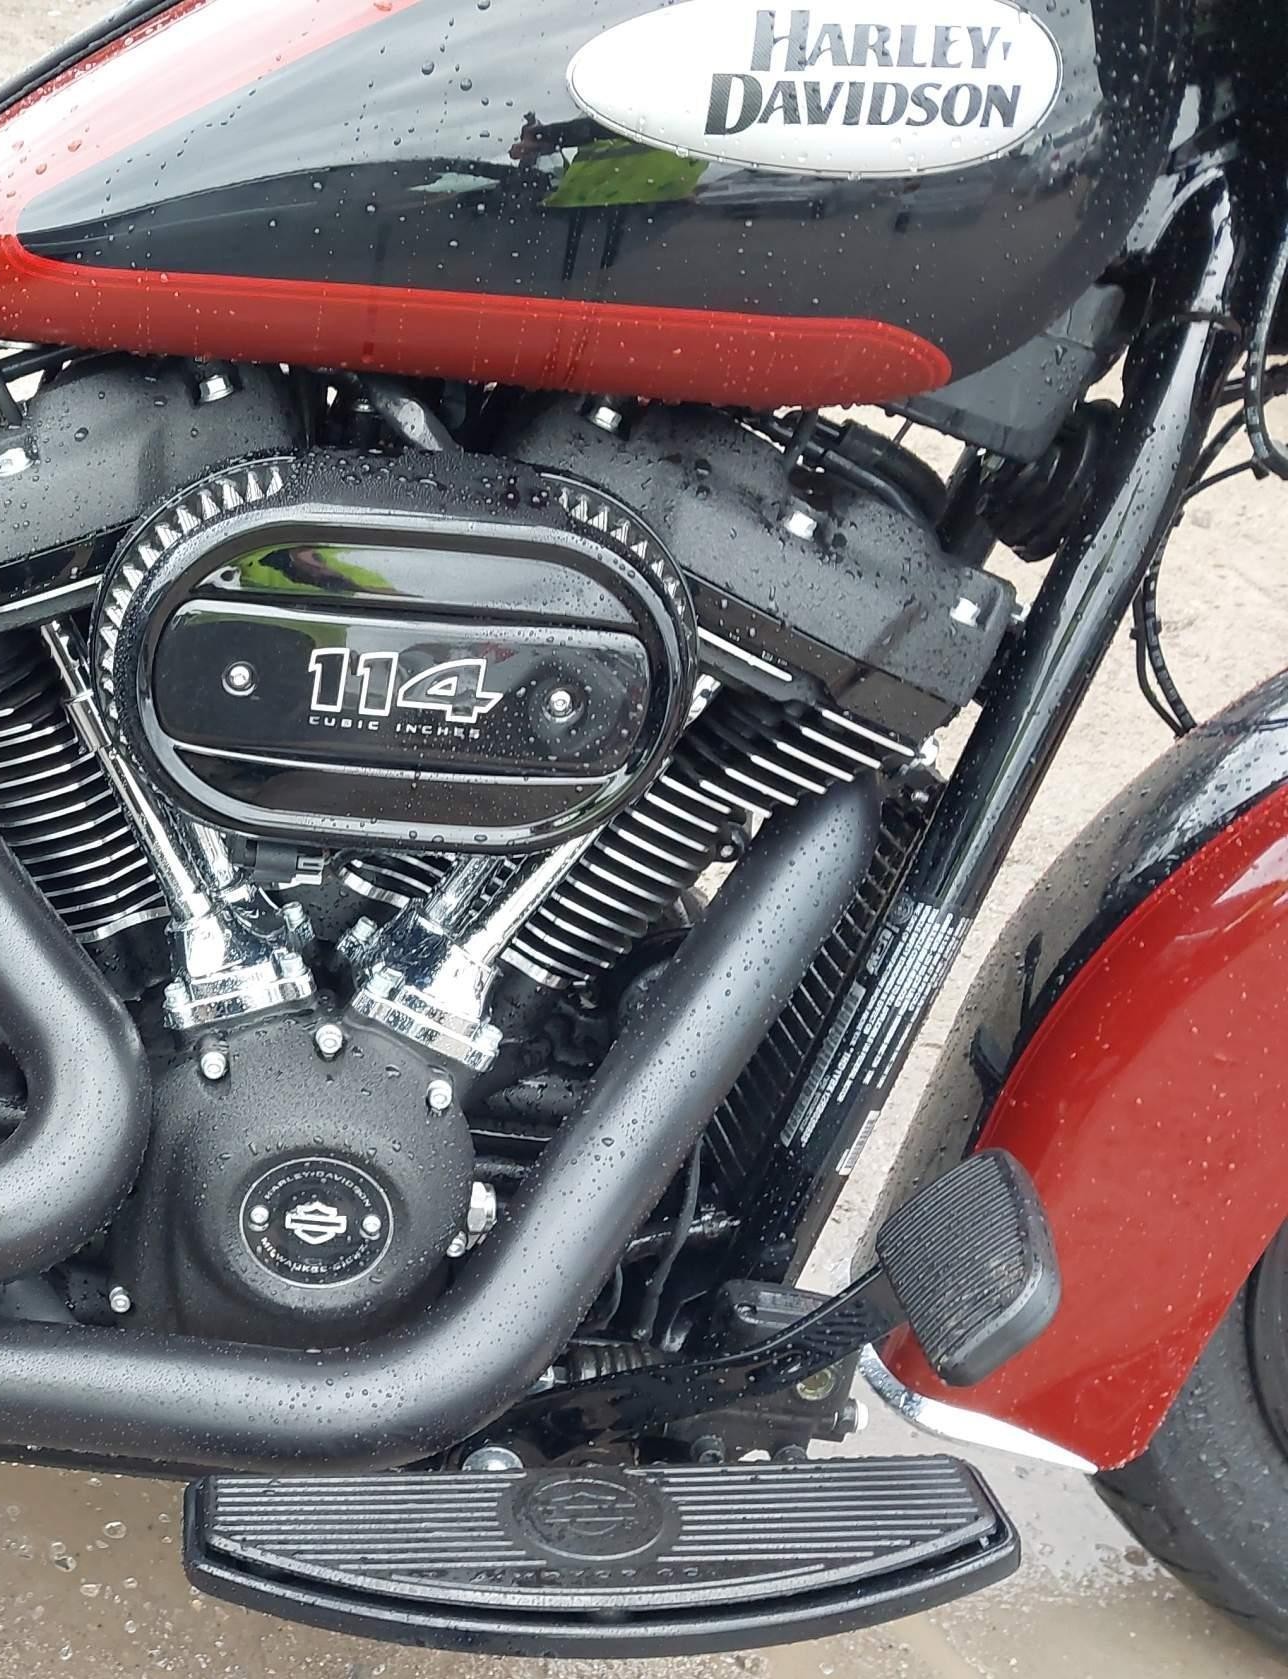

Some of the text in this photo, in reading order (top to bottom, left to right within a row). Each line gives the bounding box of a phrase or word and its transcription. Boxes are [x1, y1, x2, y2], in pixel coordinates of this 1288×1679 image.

[703, 73, 1022, 136] DAVIDSON
[308, 647, 504, 724] 114
[308, 715, 481, 740] CUBIC INCHES
